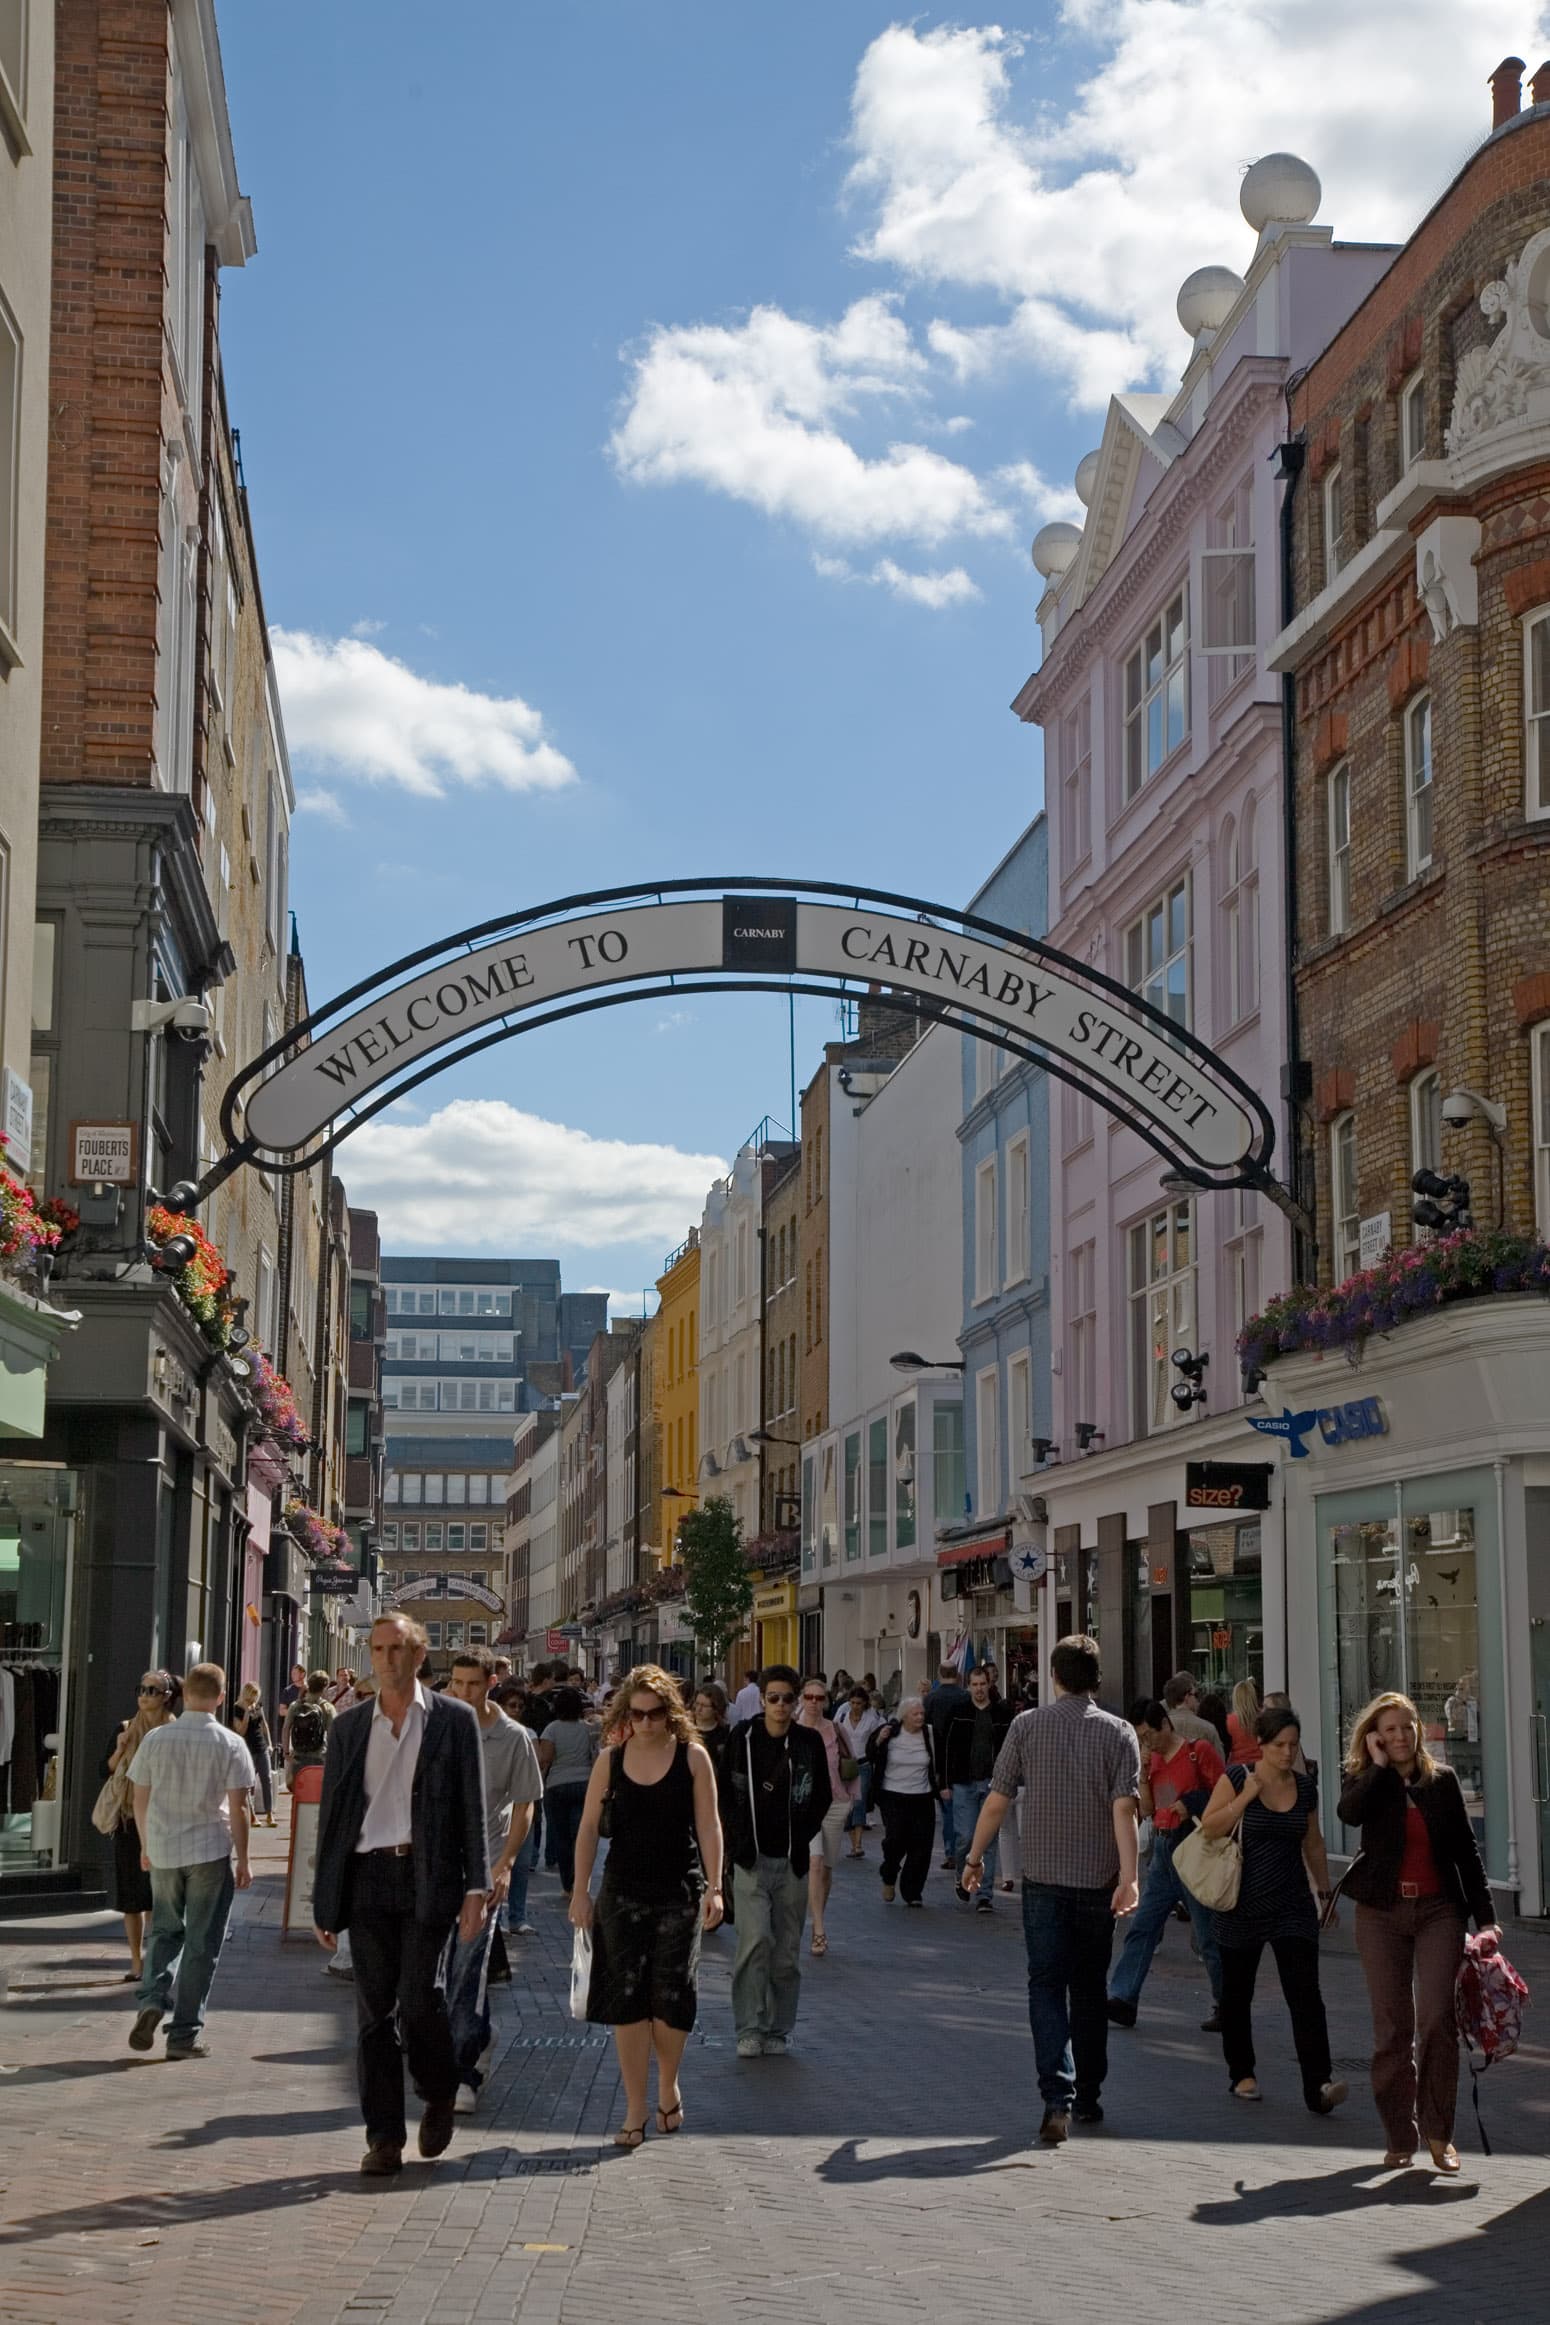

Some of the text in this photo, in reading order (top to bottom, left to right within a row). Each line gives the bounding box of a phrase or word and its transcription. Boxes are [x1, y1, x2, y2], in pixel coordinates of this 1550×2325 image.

[734, 928, 785, 939] CARNABY
[314, 927, 1217, 1129] WELCOME TO CARNABY STREET
[81, 1159, 113, 1175] PLACE
[1362, 1220, 1382, 1239] CARNABY
[1362, 1238, 1378, 1256] STREET
[1257, 1421, 1290, 1430] CASIO
[1318, 1396, 1386, 1445] CASIO
[1190, 1484, 1243, 1506] size?
